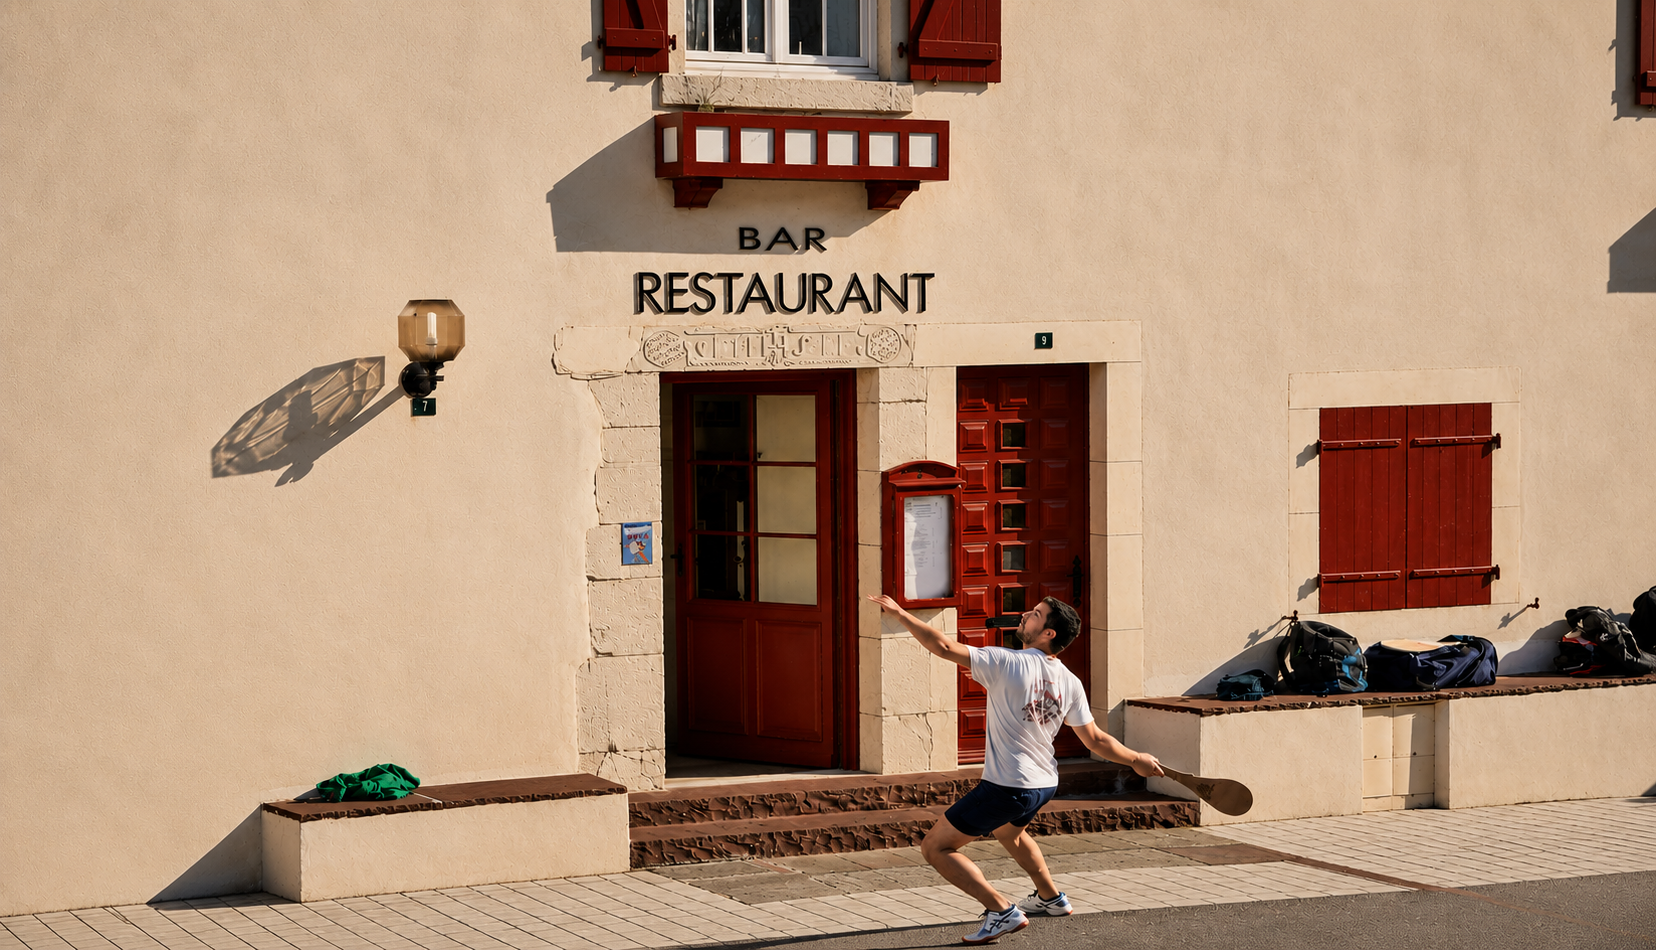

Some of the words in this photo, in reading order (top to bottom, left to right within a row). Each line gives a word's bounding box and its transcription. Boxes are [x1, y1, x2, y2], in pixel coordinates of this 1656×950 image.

[738, 226, 827, 252] BAR
[635, 272, 935, 314] RESTAURANT
[1041, 335, 1047, 346] 9
[422, 400, 428, 412] 7
